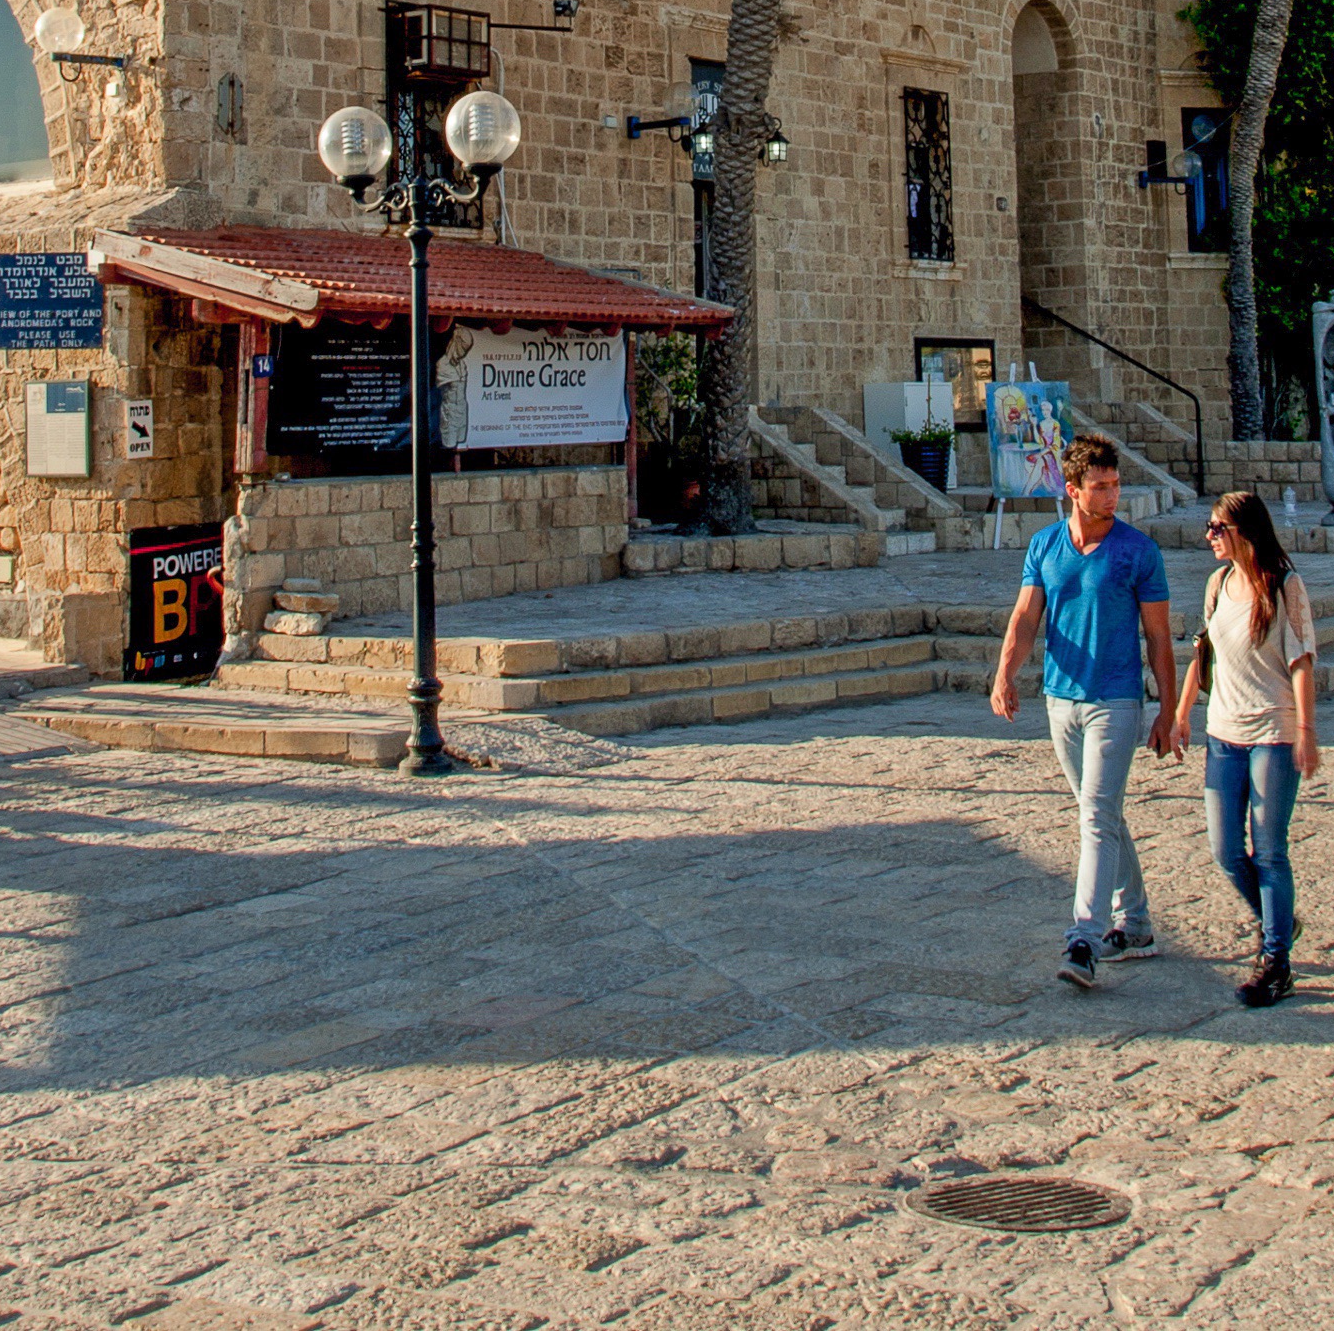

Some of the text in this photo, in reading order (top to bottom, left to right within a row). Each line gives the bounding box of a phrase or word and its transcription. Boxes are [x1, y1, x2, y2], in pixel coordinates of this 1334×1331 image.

[15, 255, 83, 265] מבט לנמל
[64, 265, 97, 276] סלע
[2, 277, 95, 289] המעבר לאורך
[6, 288, 91, 299] השביל בלבד
[19, 310, 32, 319] OF
[34, 309, 51, 319] THE
[55, 309, 79, 319] PORT
[82, 308, 102, 318] AND
[69, 318, 95, 327] ROCK
[18, 330, 76, 339] PLEASE USE
[11, 340, 27, 348] THE
[33, 339, 56, 348] PATH
[522, 337, 611, 361] חסד אלוהי
[258, 359, 271, 374] 14
[482, 363, 586, 388] Divine Grace
[481, 390, 511, 401] Art Event
[129, 441, 151, 453] OPEN
[153, 547, 223, 580] POWERE
